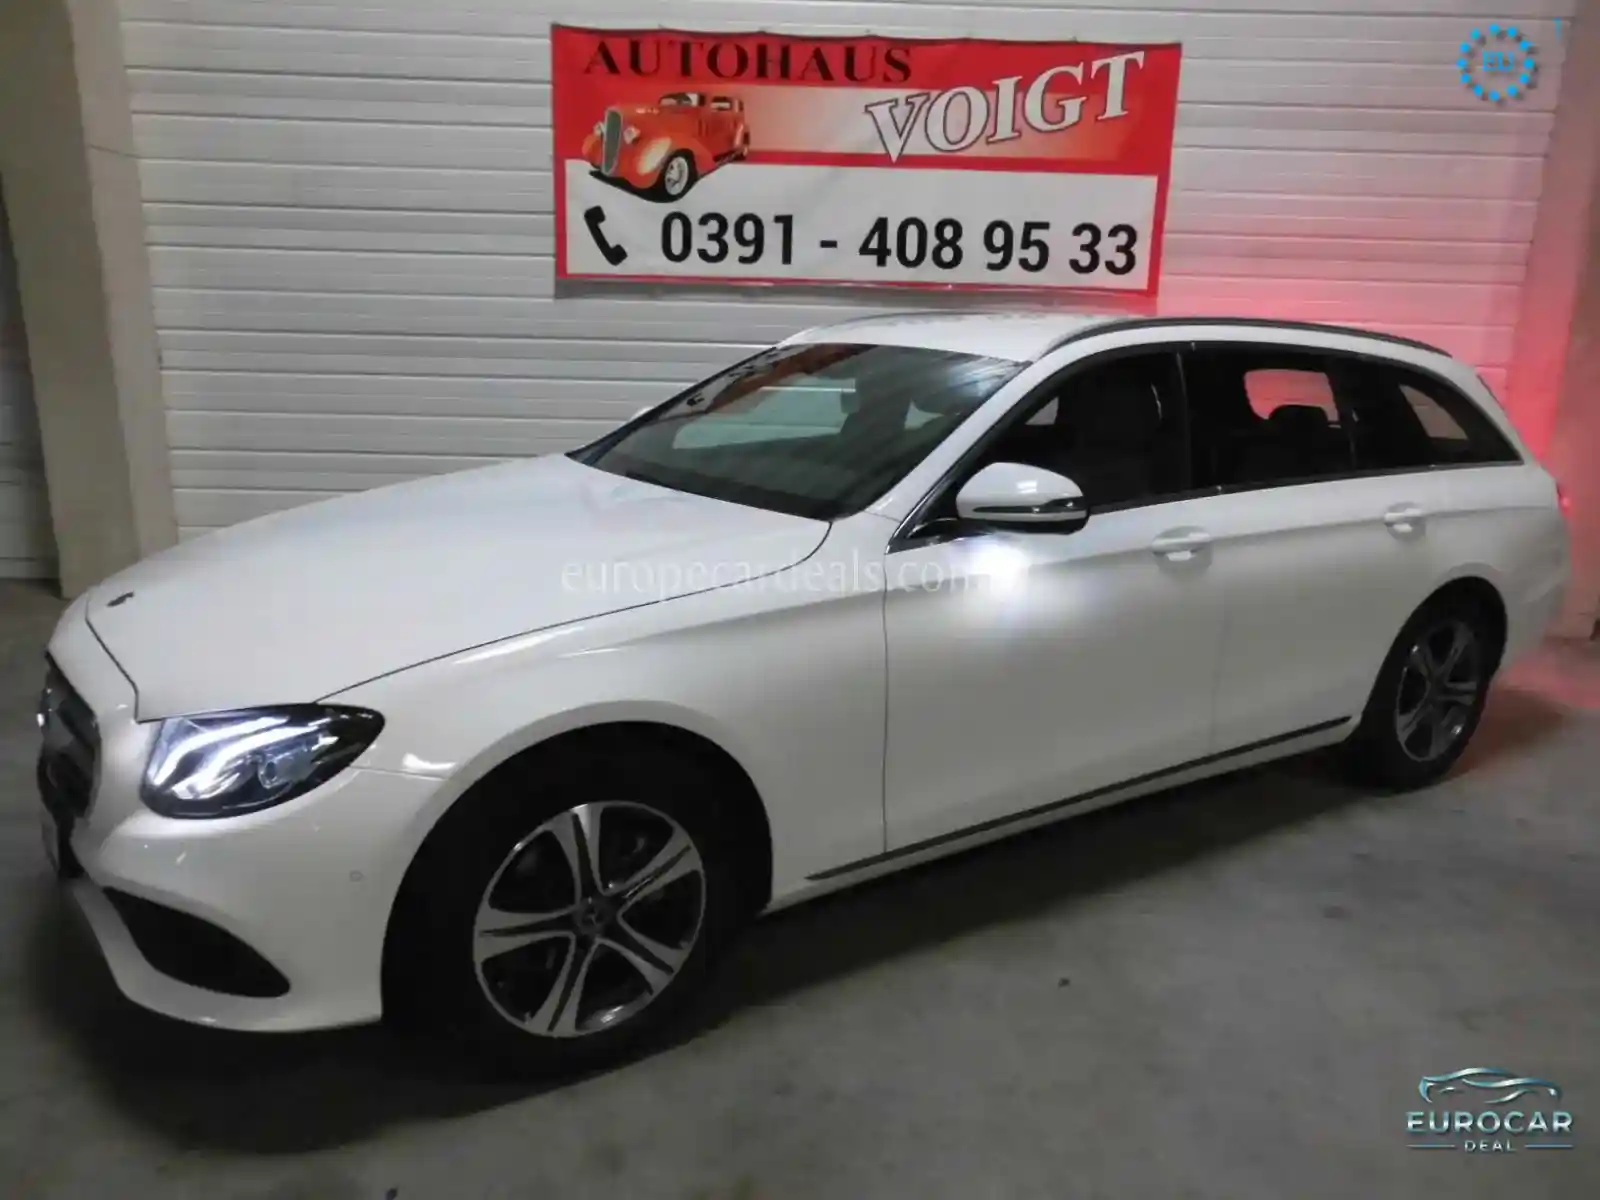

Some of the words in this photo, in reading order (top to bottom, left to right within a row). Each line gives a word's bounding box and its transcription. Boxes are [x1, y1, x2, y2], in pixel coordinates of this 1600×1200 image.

[584, 38, 911, 83] AUTOHAUS
[865, 51, 1145, 163] VOIGT
[661, 211, 794, 265] 0391
[858, 216, 963, 270] 408
[983, 219, 1051, 273] 95
[1068, 222, 1138, 275] 33
